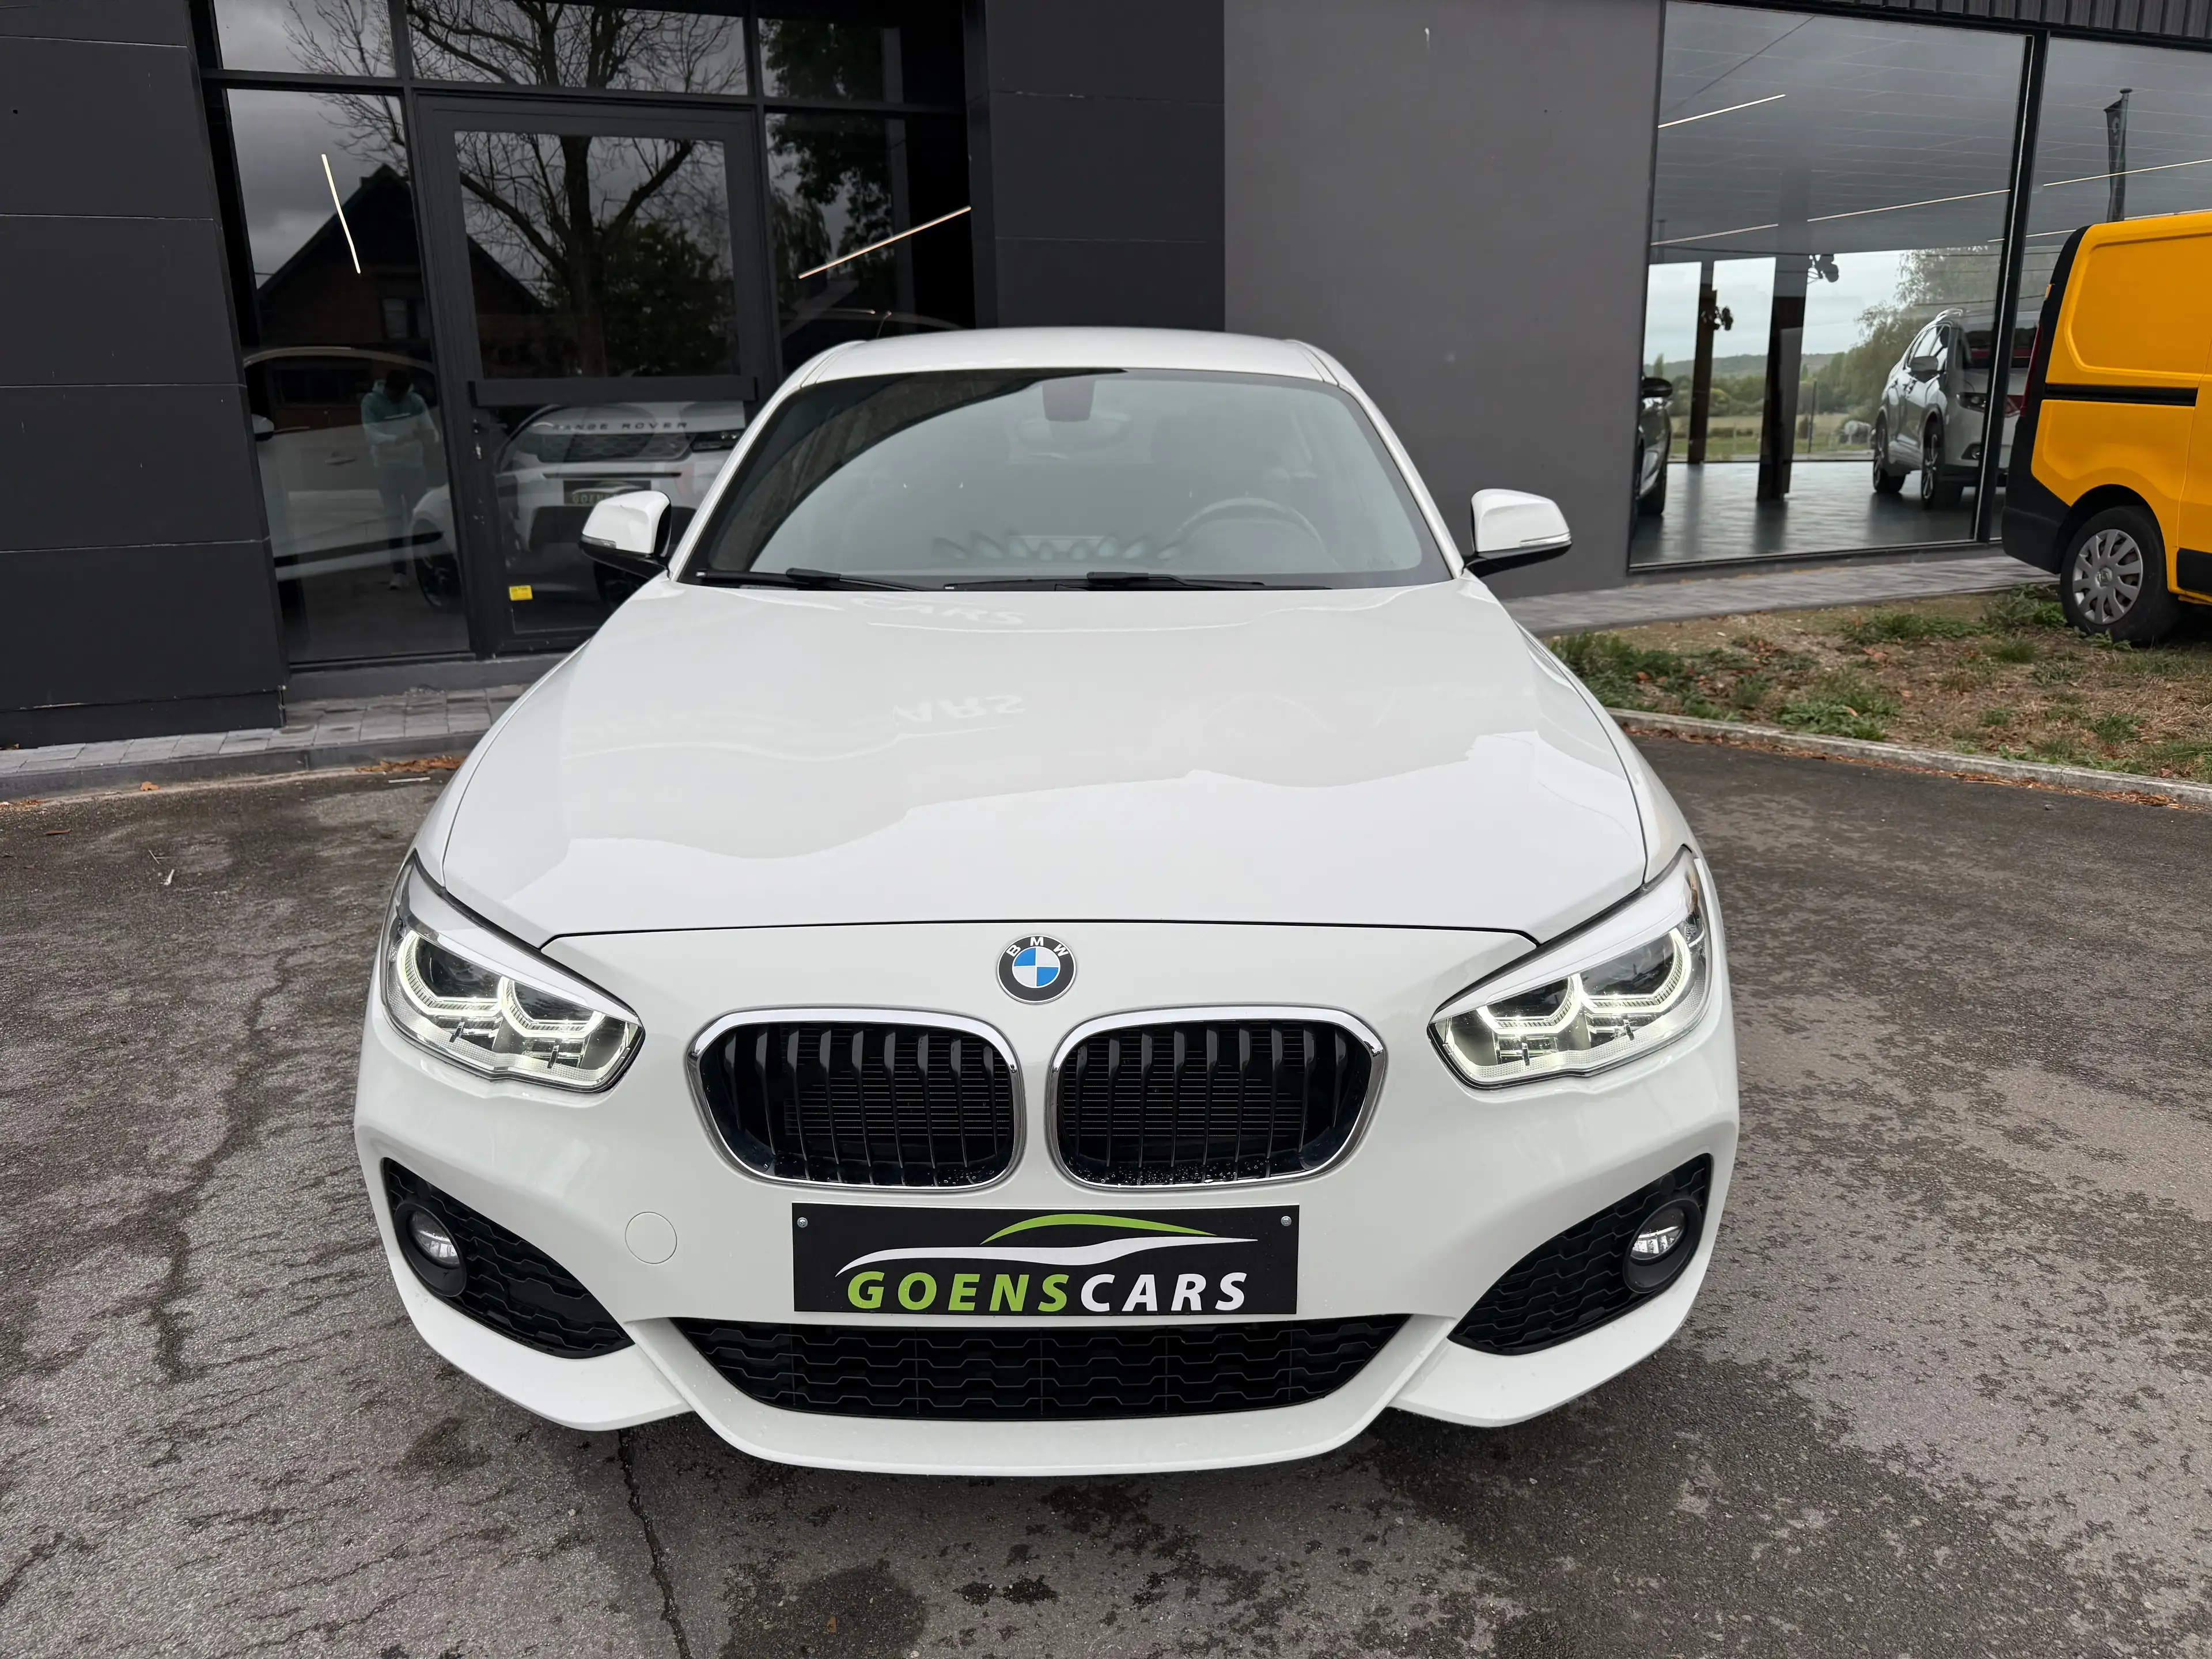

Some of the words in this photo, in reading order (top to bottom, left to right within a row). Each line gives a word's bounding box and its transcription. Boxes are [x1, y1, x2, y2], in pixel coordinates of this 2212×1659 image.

[552, 423, 608, 431] RANGE
[622, 422, 687, 430] ROVER
[1006, 937, 1069, 957] BMW
[848, 1271, 1247, 1312] GOENSCARS
